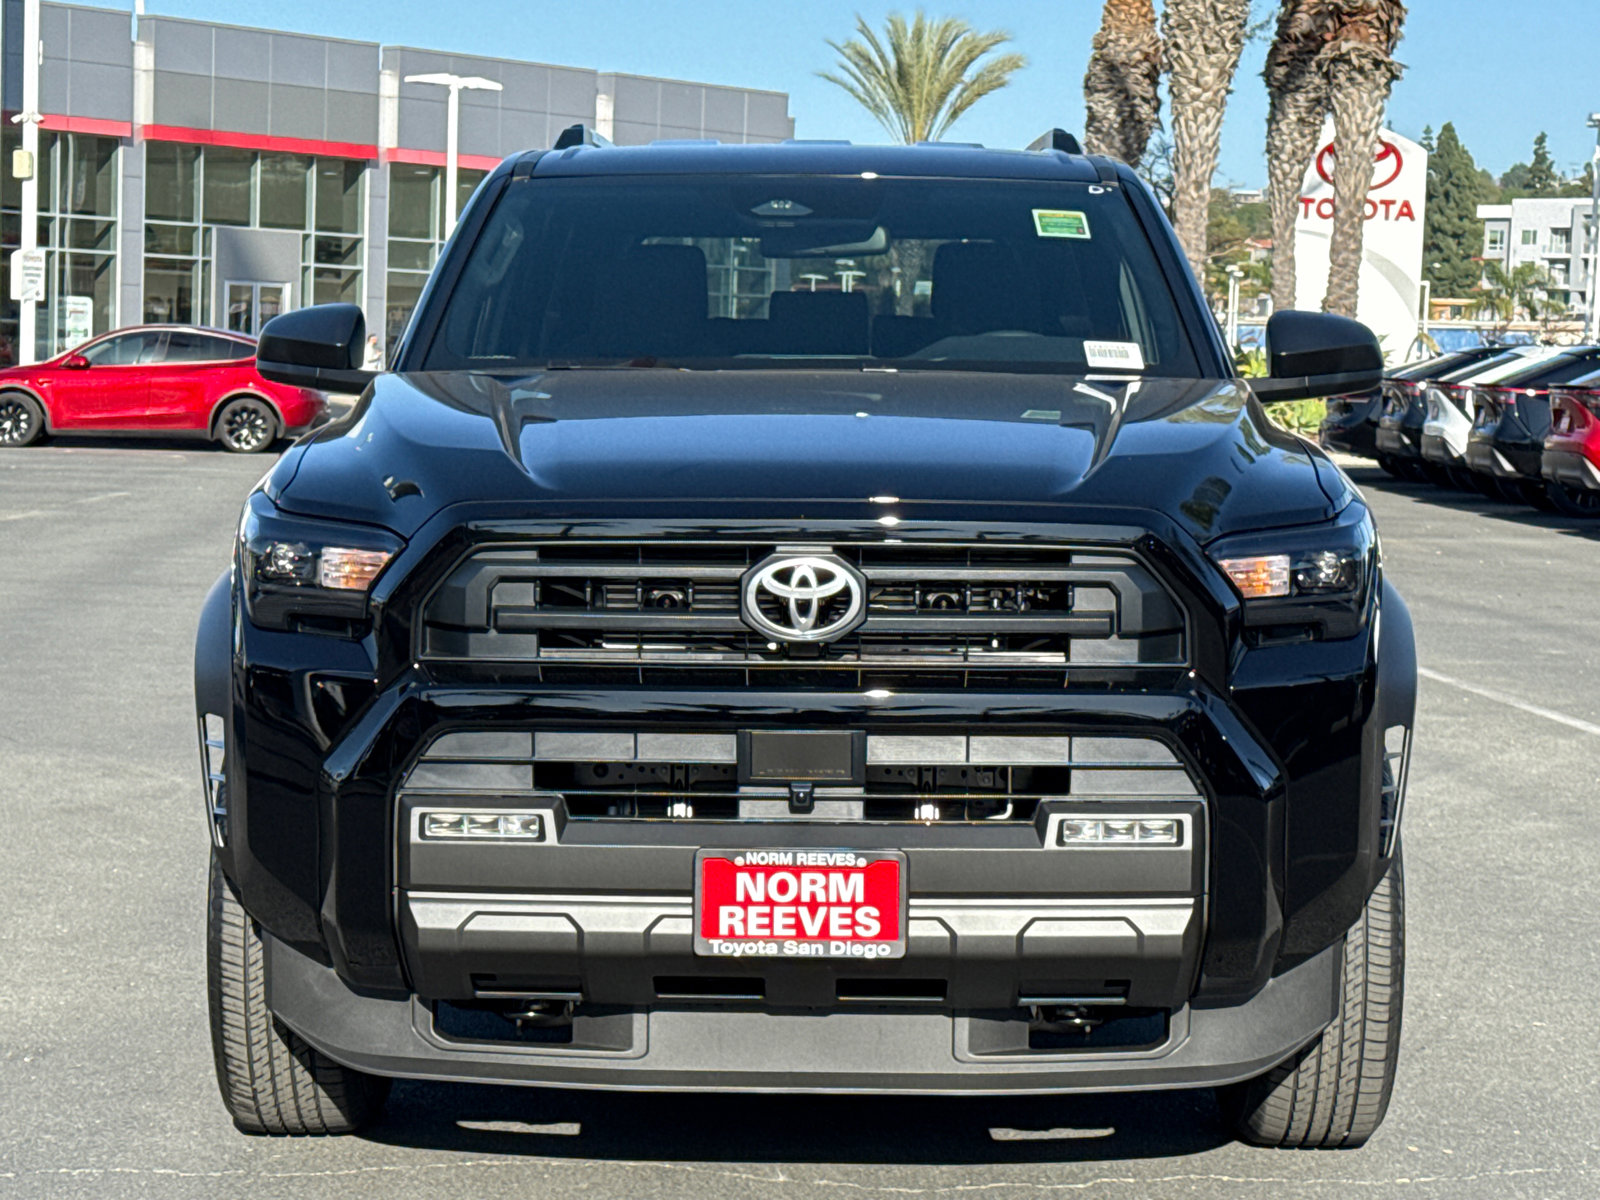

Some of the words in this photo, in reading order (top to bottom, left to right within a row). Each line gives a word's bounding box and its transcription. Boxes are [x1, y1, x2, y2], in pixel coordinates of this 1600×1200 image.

[1299, 197, 1416, 222] TOOTA
[746, 852, 793, 866] NORM
[797, 852, 856, 866] REEVES
[735, 871, 865, 903] NORM
[718, 905, 881, 937] REEVES
[708, 939, 778, 957] Toyota
[783, 940, 824, 956] San
[829, 940, 891, 959] Diego
